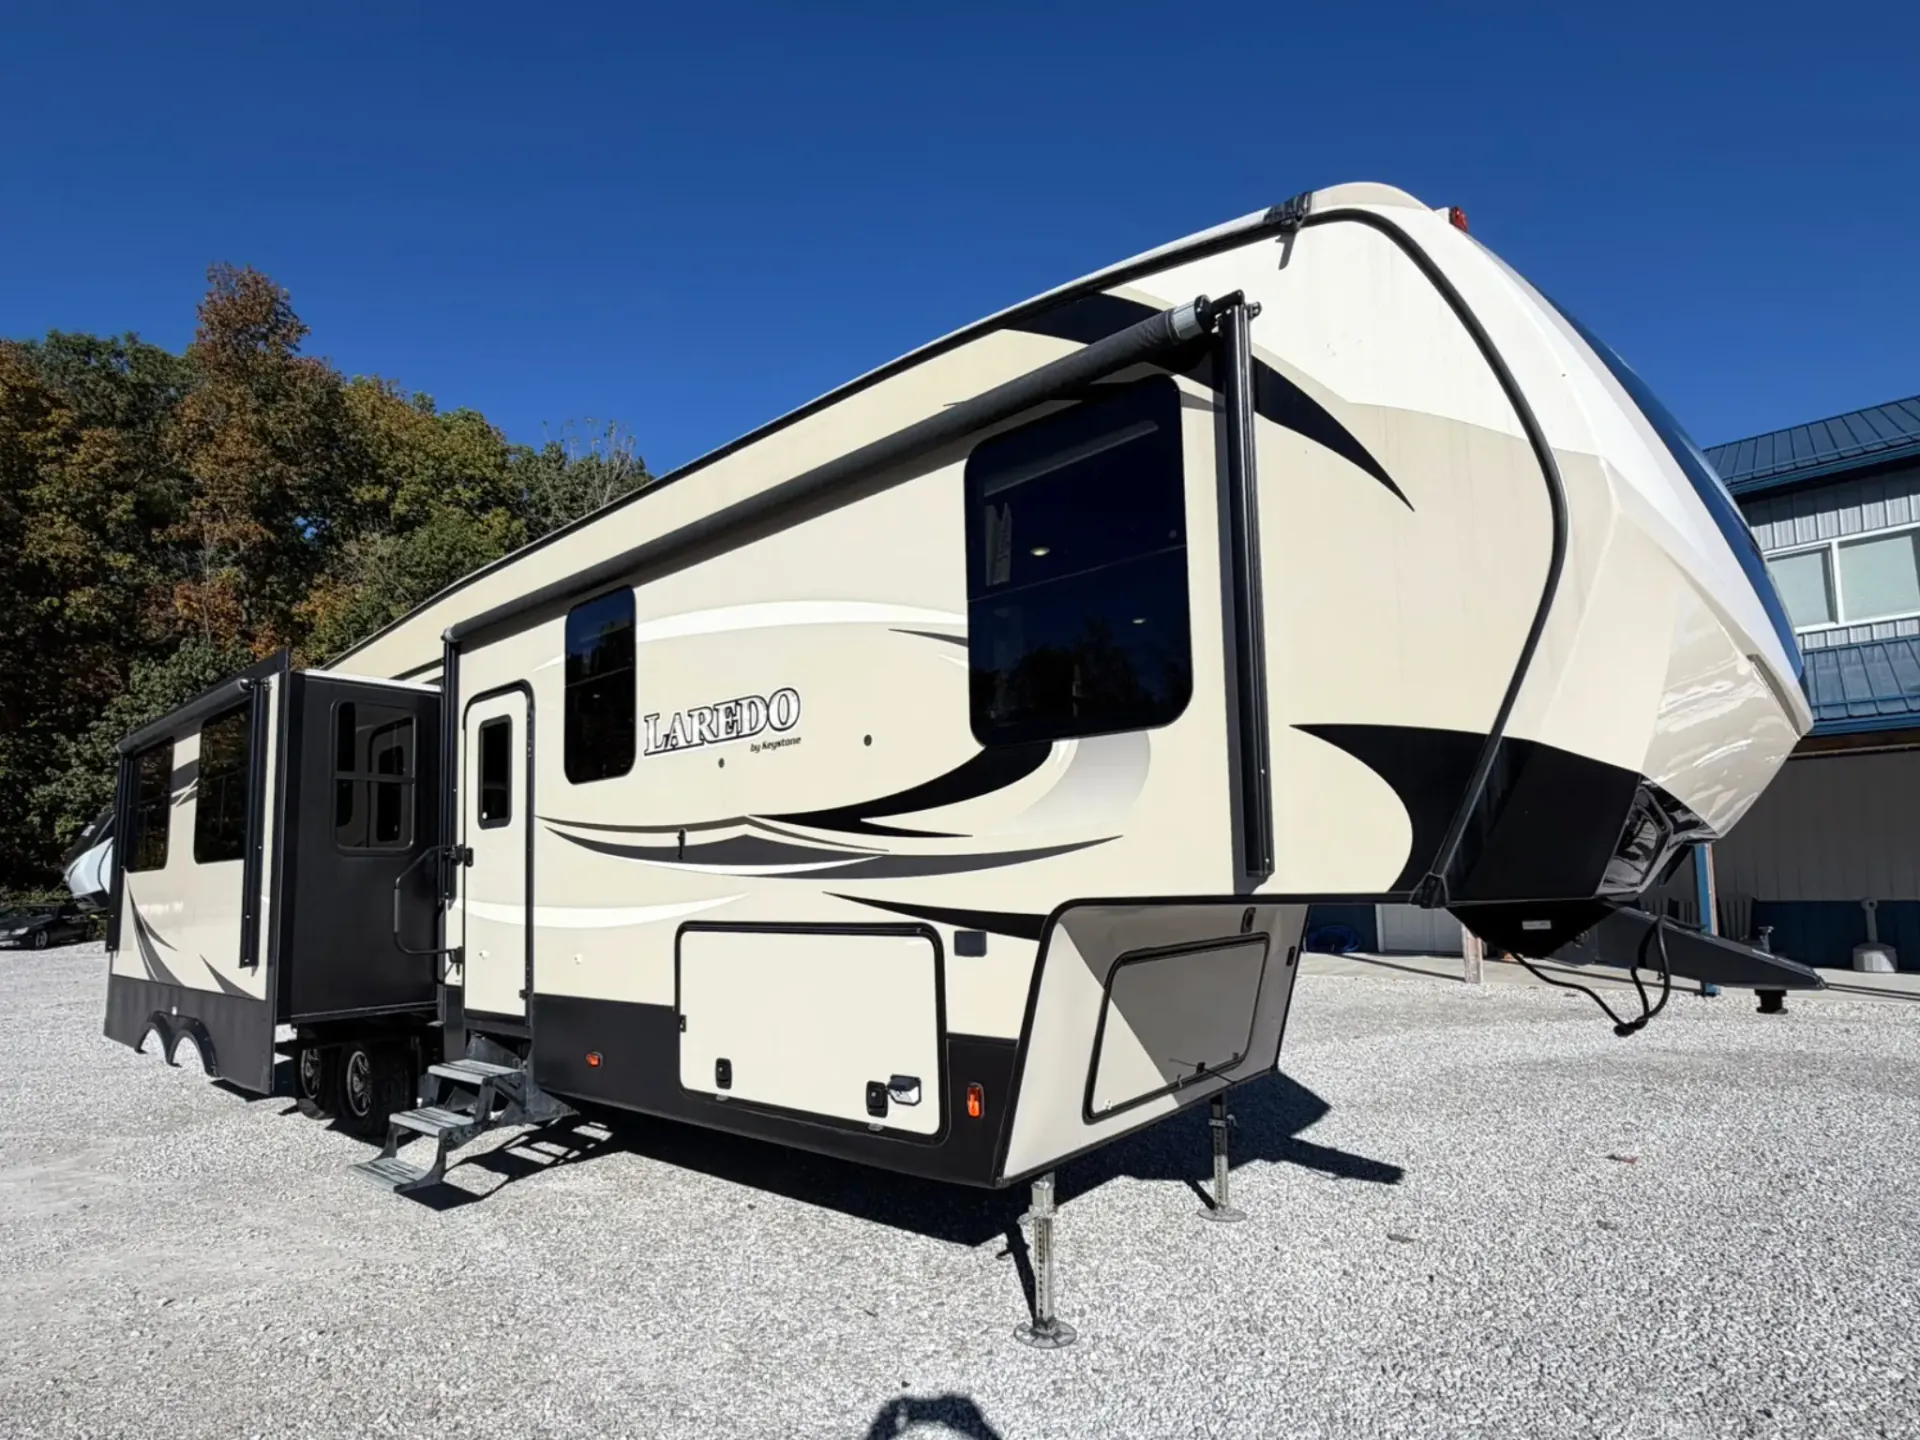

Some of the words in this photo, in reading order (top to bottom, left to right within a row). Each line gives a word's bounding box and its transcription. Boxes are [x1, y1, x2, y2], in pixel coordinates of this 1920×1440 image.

[644, 687, 800, 756] LAREDO
[750, 743, 761, 754] by
[762, 737, 802, 751] Keystone
